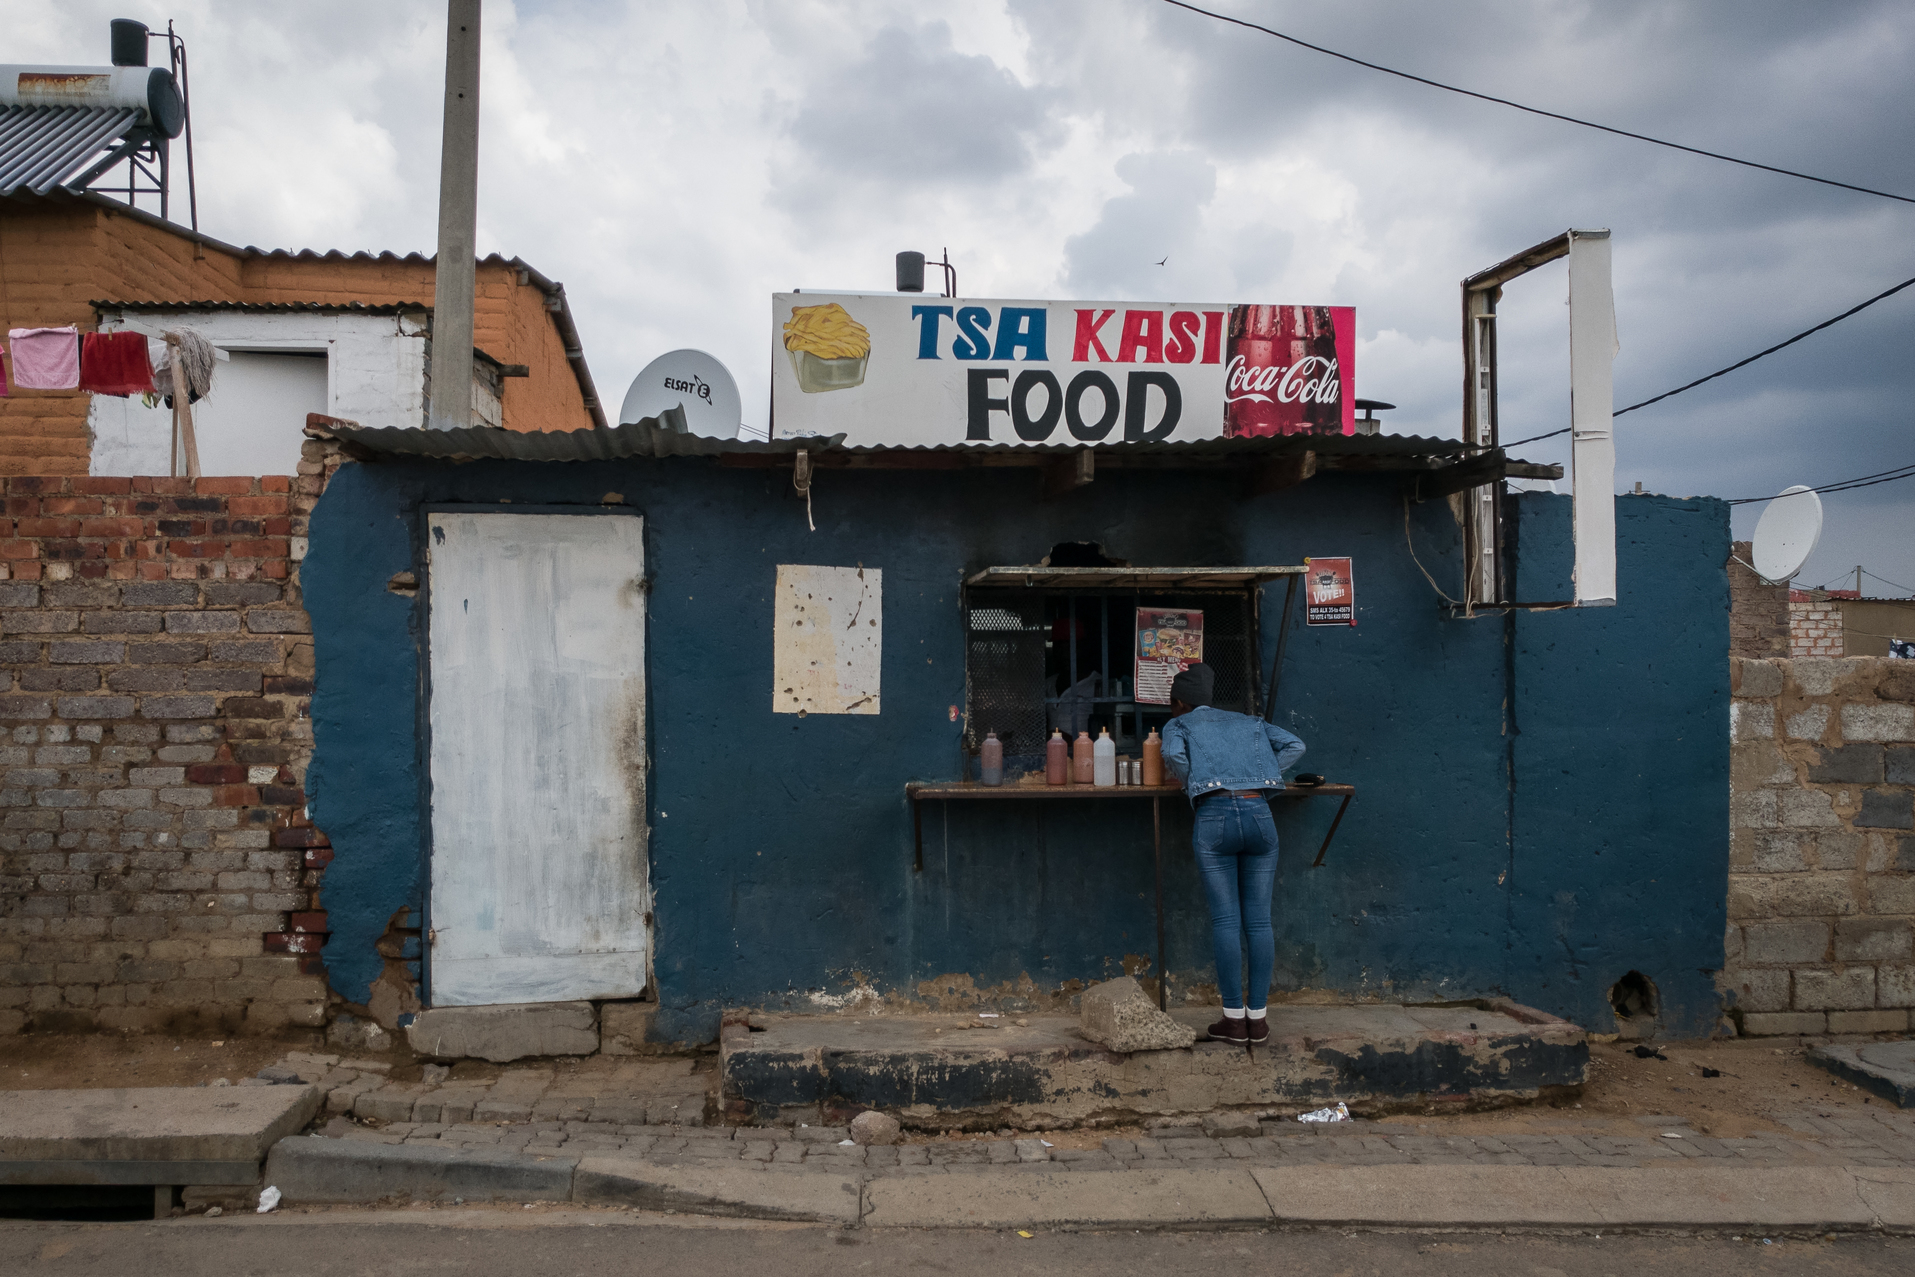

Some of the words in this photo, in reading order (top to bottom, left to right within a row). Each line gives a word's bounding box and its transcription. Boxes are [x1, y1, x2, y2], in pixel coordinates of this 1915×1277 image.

[911, 305, 1050, 361] TSA
[1073, 308, 1224, 365] KASI
[664, 377, 696, 394] ELSAT
[1224, 354, 1339, 404] Coca-Cola
[965, 368, 1184, 443] FOOD
[1313, 589, 1345, 604] VOTE!!
